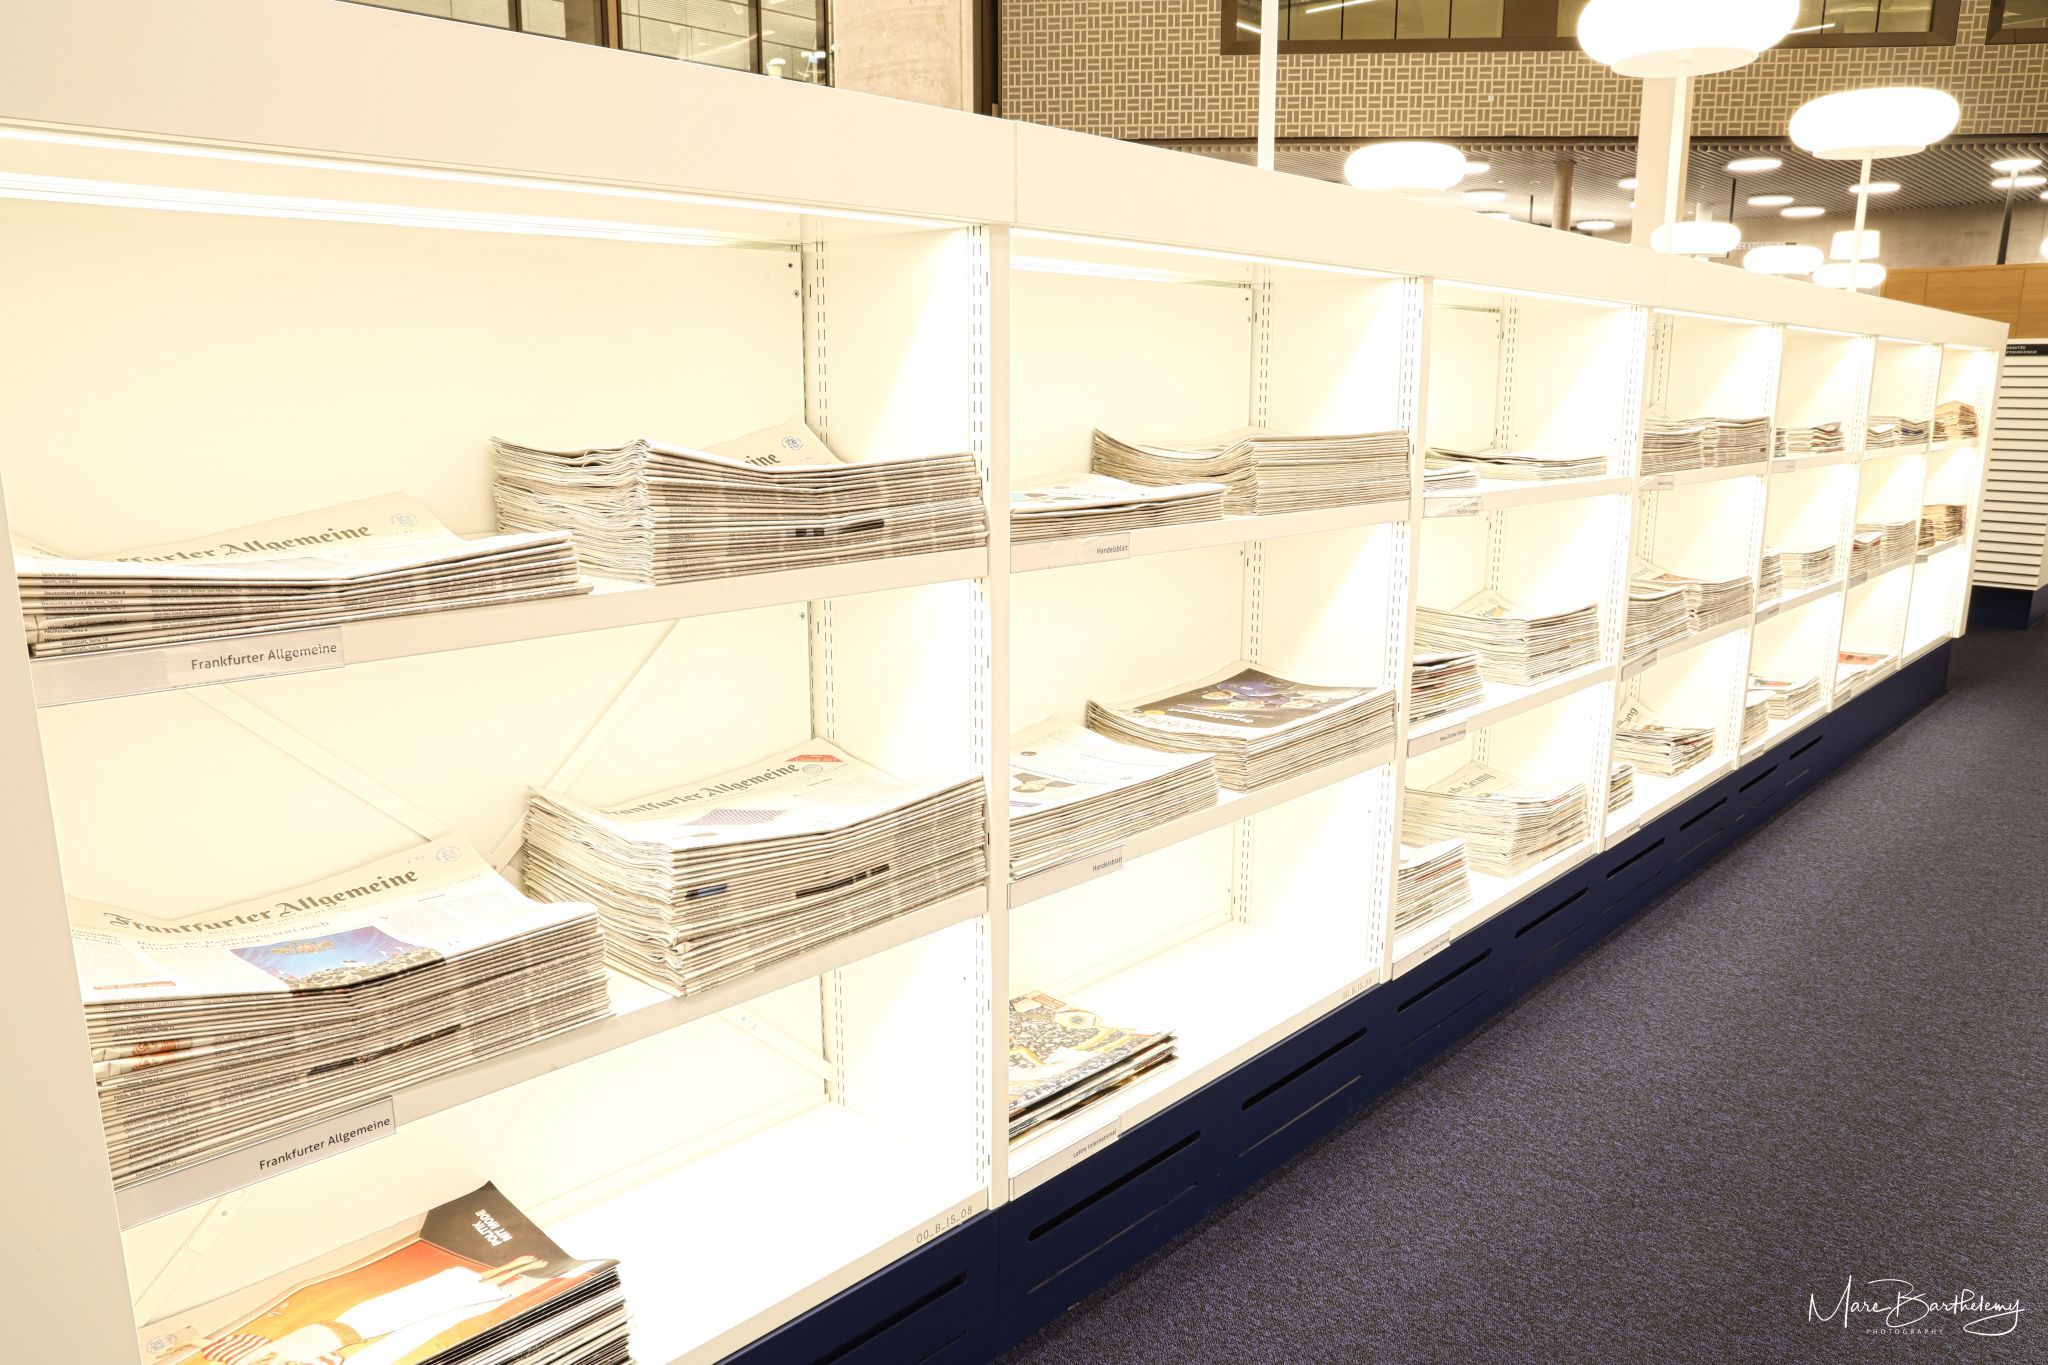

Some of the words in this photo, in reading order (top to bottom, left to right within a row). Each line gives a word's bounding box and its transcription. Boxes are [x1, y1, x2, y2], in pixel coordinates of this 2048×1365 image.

[219, 526, 372, 556] Allgemeine
[190, 652, 265, 671] Frankfurter
[267, 643, 338, 662] Allgemeine
[699, 763, 800, 798] Allgemeine
[1092, 855, 1123, 873] Handelsblatt
[275, 870, 419, 918] Allgemeine
[259, 1140, 325, 1171] Frankfurter
[327, 1117, 391, 1147] Allgemeine
[1087, 1128, 1117, 1150] International
[474, 1208, 501, 1230] MODE
[472, 1220, 503, 1247] POLITIK
[494, 1229, 514, 1243] MIT
